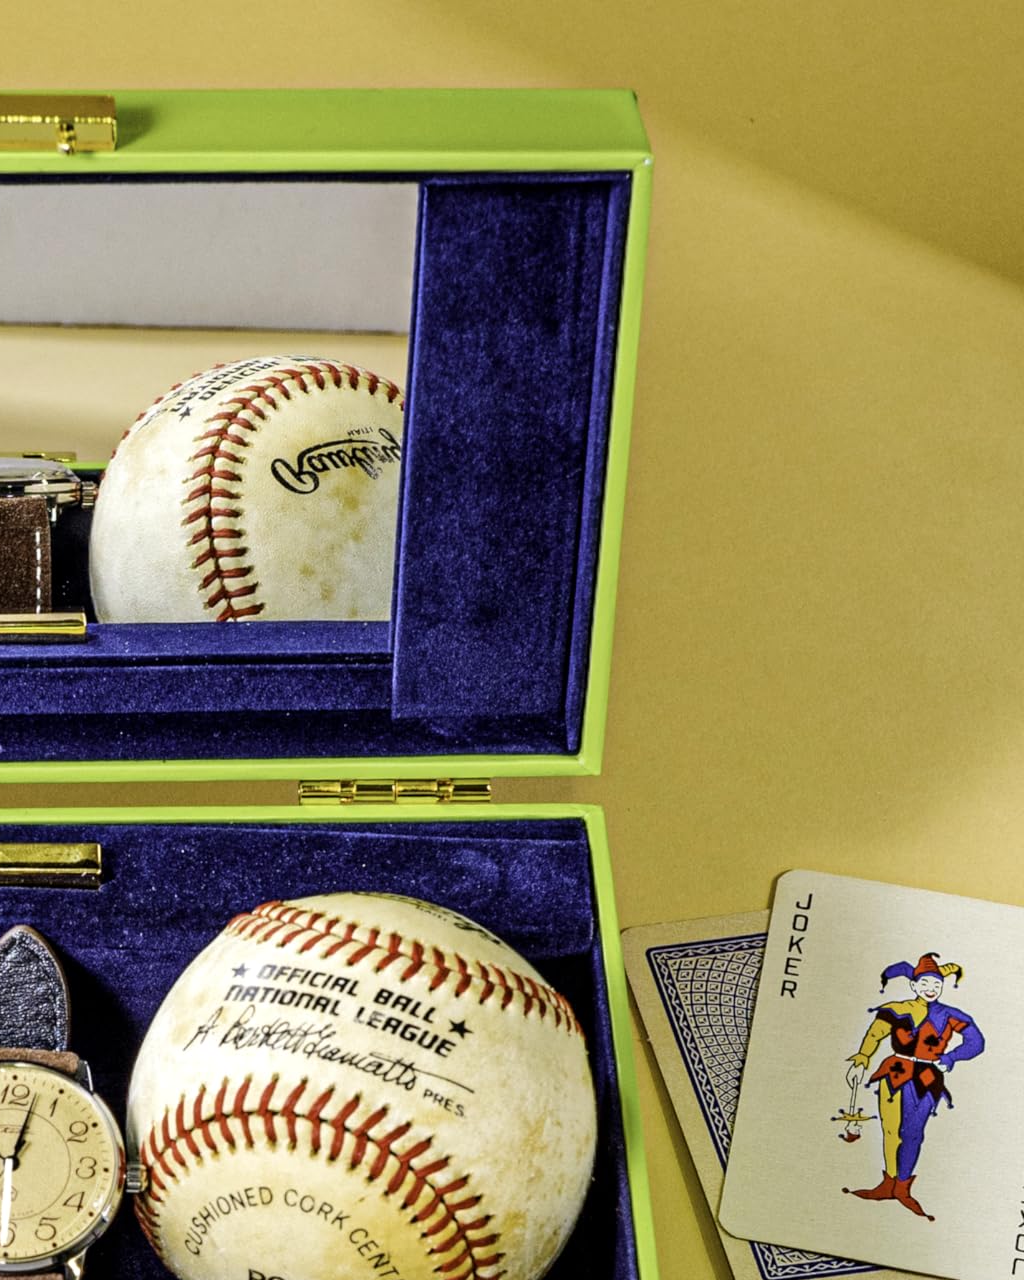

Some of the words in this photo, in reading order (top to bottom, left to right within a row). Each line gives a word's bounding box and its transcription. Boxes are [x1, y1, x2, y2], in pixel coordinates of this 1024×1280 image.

[780, 893, 813, 999] JOKER
[255, 962, 361, 998] OFFICIAL
[373, 988, 439, 1025] BALL
[223, 983, 342, 1018] NATIONAL
[353, 1009, 456, 1059] LEAGUE
[0, 1083, 31, 1107] 12
[66, 1120, 89, 1143] 2
[75, 1156, 98, 1180] 3
[63, 1191, 86, 1212] 4
[34, 1217, 59, 1241] 5
[183, 1185, 275, 1258] CUSHIONED
[283, 1189, 350, 1231] CORK
